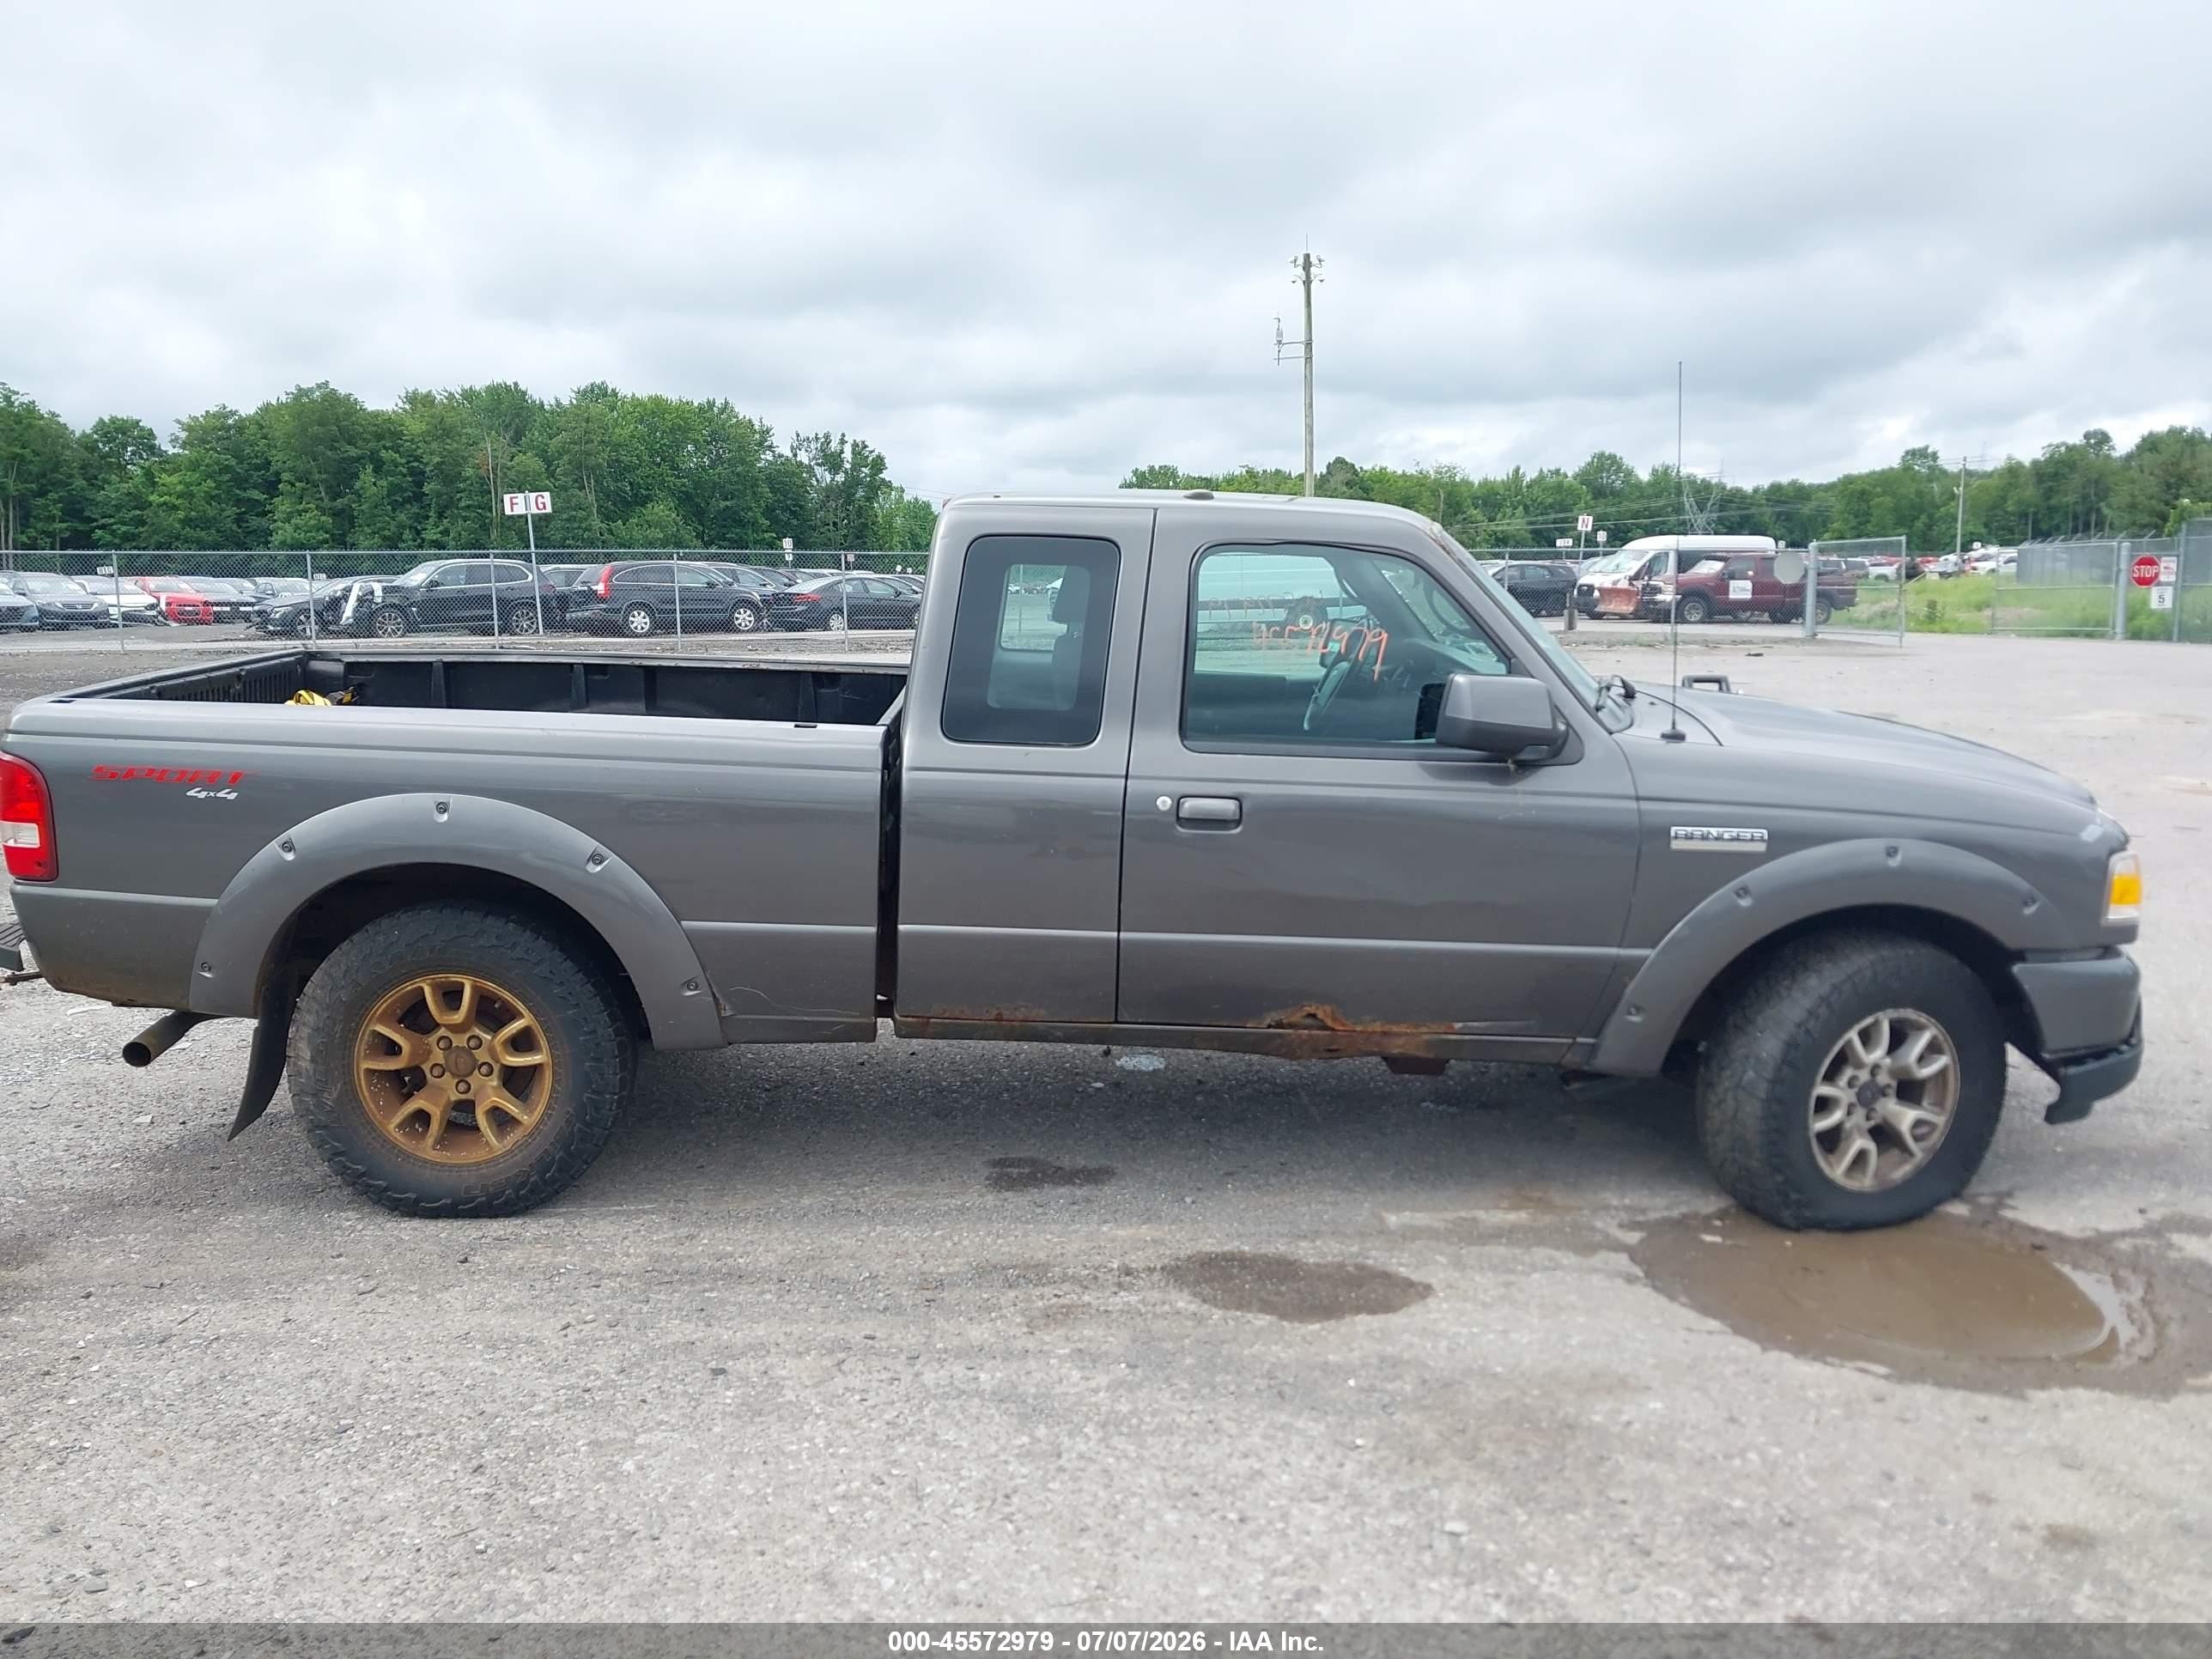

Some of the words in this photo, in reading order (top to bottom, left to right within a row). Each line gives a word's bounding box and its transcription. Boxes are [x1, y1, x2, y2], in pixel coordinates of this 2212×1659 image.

[509, 495, 519, 512] F
[535, 494, 547, 511] G
[1581, 517, 1589, 529] N
[783, 539, 792, 548] 10
[2133, 565, 2159, 578] STOP
[2158, 594, 2166, 604] 5
[88, 764, 246, 786] SPORT
[185, 787, 239, 800] 4x4
[1674, 829, 1765, 842] RANGER
